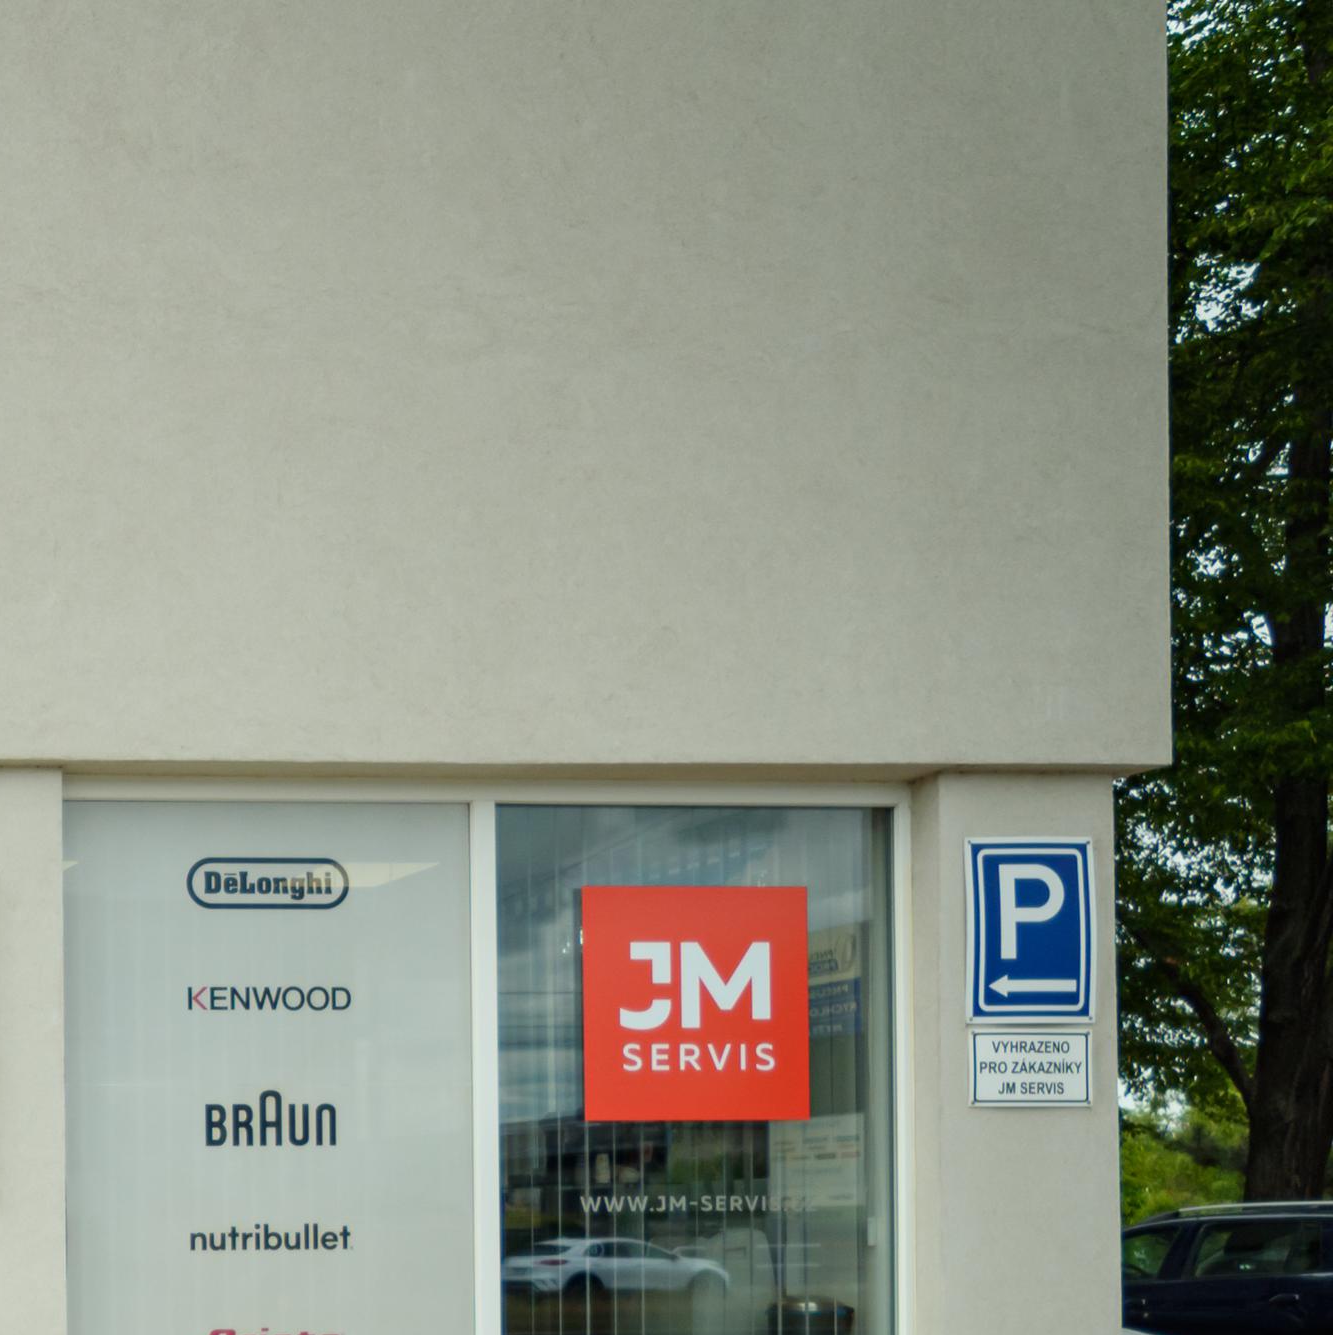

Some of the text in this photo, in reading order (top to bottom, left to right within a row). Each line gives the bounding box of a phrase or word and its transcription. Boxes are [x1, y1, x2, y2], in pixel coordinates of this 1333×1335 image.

[998, 863, 1065, 961] P
[187, 986, 352, 1011] KENWOOD
[620, 941, 771, 1029] JM
[622, 1043, 776, 1071] SERVIS
[992, 1040, 1070, 1054] VYHRAZENO
[979, 1058, 1082, 1074] PRO ZÁKAZNÍKY
[998, 1081, 1065, 1095] JM SERVIS
[205, 1089, 337, 1147] BRAUN
[190, 1223, 351, 1252] nutribullet
